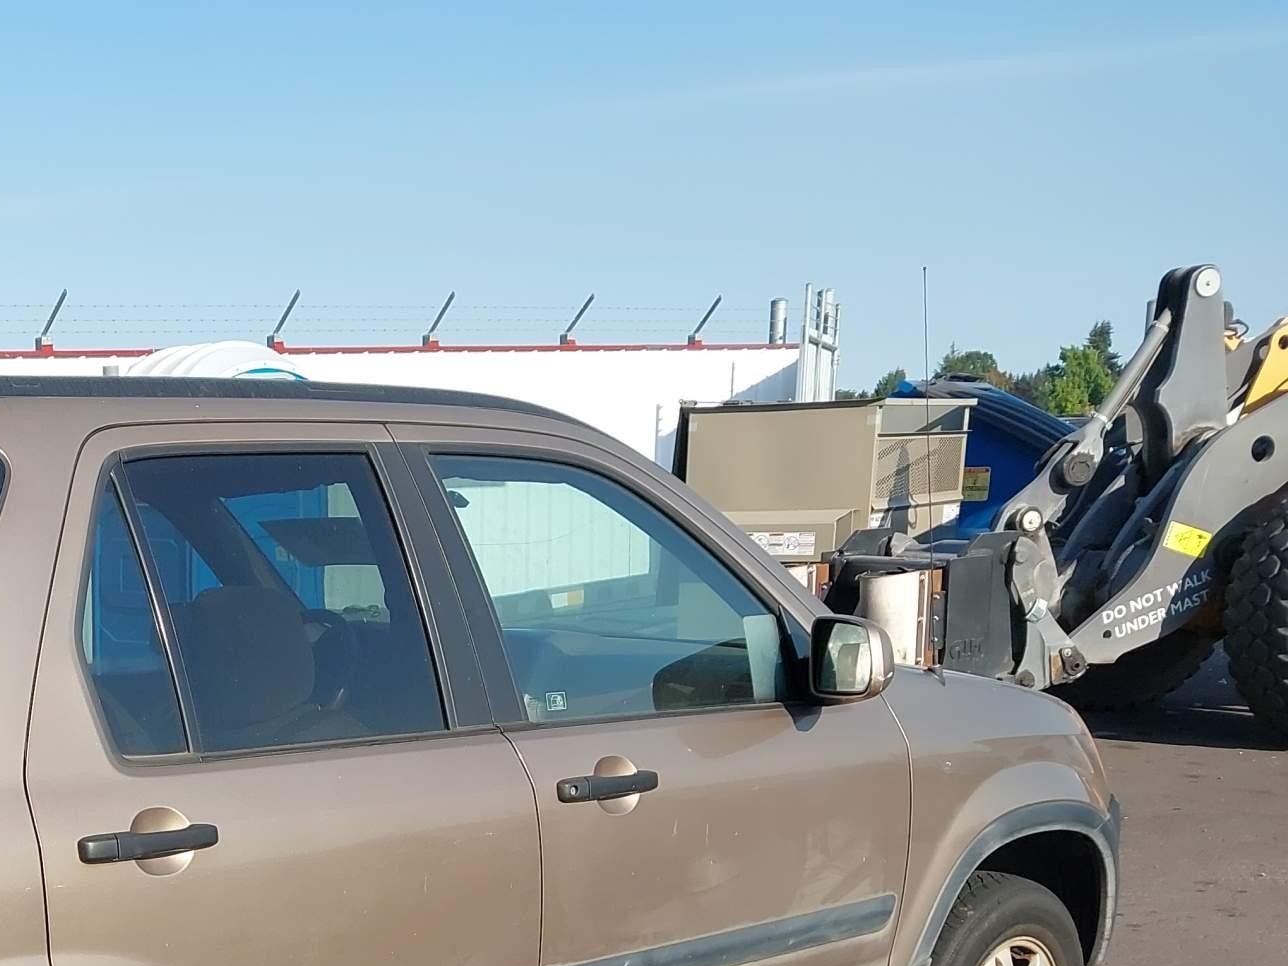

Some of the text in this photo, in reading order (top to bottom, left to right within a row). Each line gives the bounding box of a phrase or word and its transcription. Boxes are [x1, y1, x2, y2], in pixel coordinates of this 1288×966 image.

[1102, 568, 1213, 624] DO NOT WALK
[1114, 588, 1210, 638] UNDER MAST
